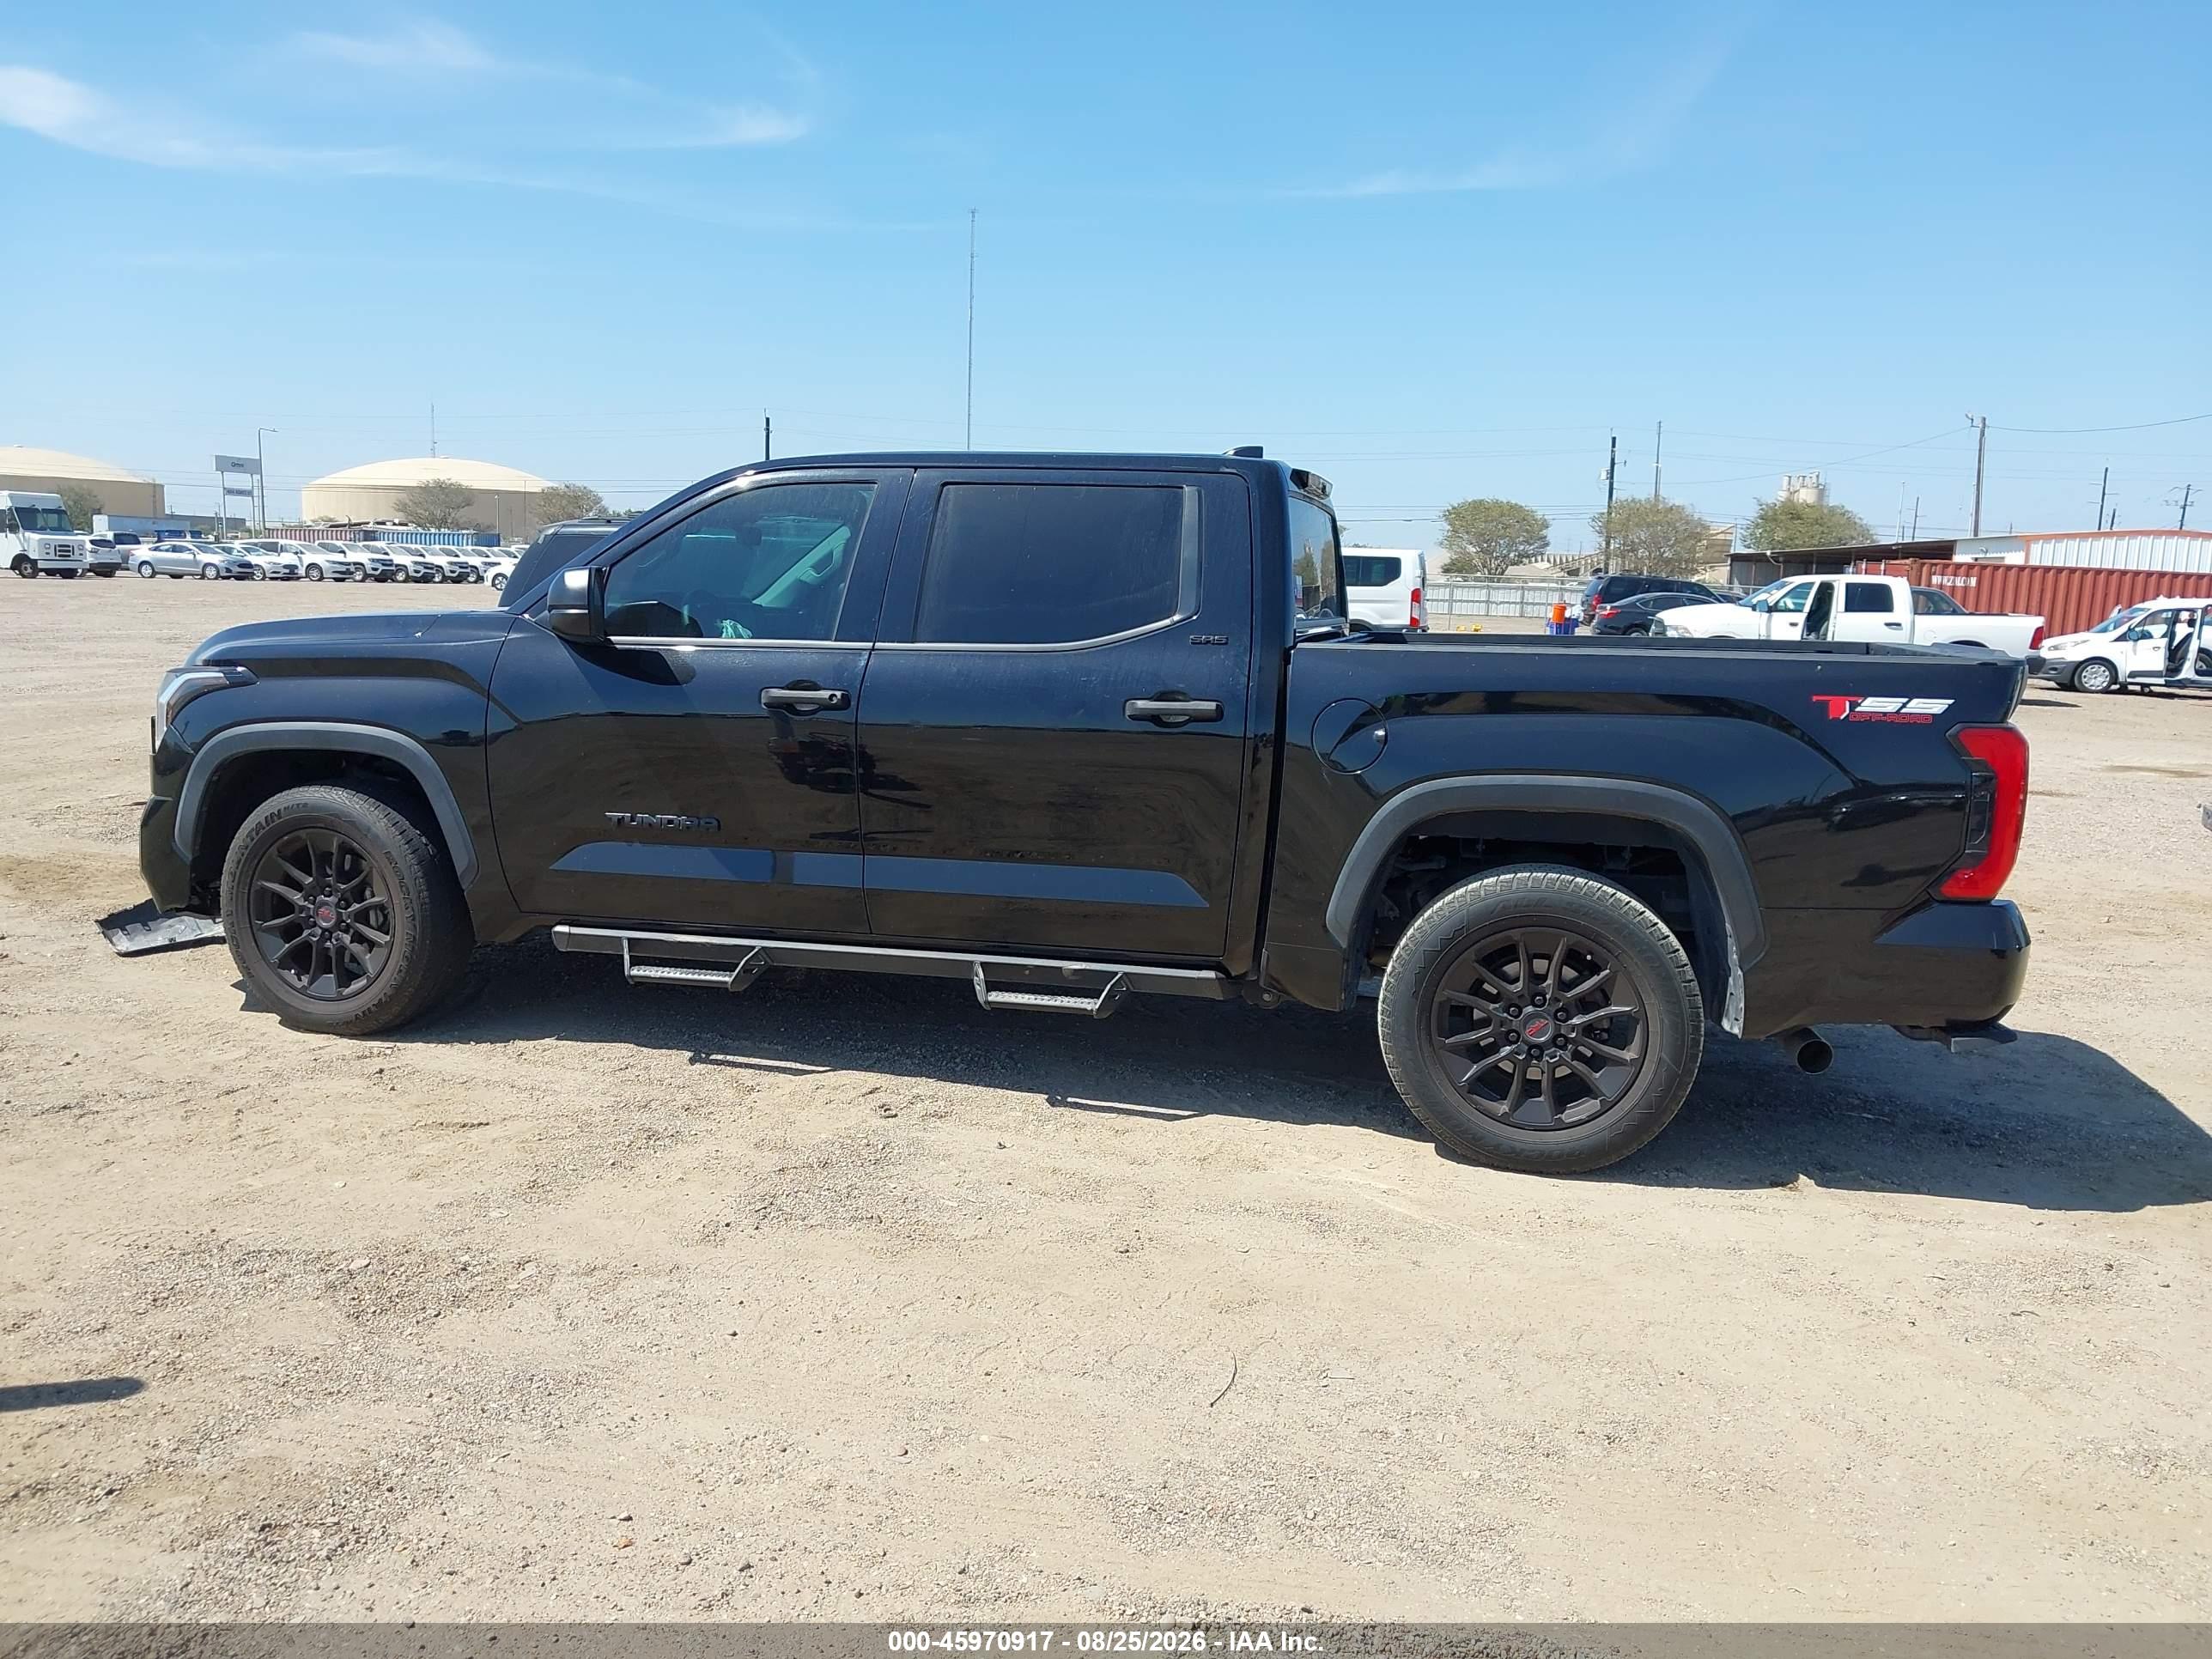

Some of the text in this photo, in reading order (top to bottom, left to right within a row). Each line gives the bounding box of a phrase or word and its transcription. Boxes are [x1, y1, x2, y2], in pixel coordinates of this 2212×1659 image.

[1189, 635, 1230, 646] SR5
[1849, 712, 1933, 724] OFF-ROAD
[604, 811, 722, 832] TUNDRA
